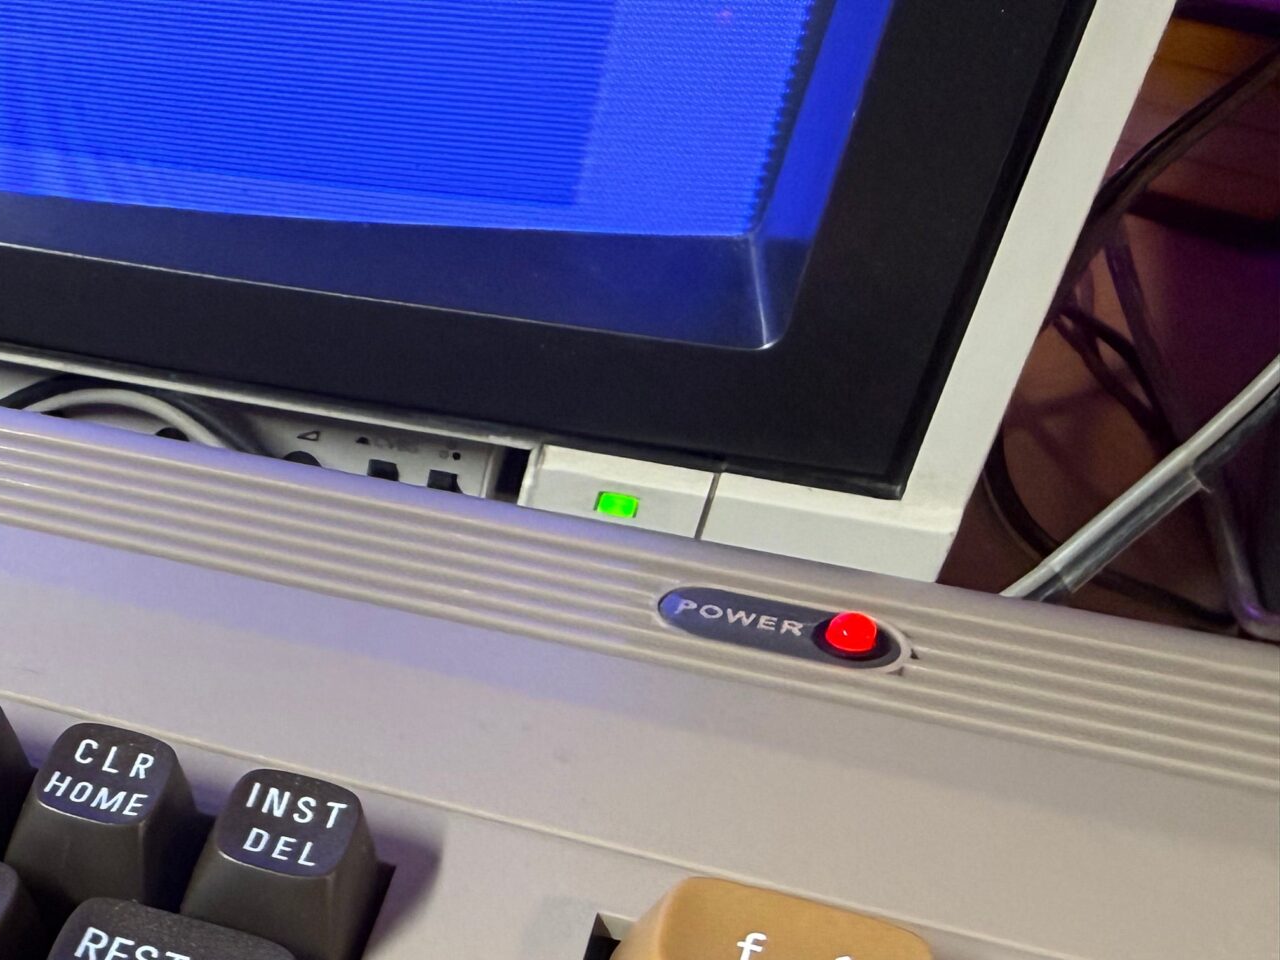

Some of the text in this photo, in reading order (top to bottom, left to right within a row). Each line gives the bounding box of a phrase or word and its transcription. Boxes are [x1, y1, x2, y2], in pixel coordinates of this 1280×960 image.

[672, 597, 805, 638] POWER
[73, 738, 155, 780] CLR
[42, 770, 150, 817] HOME
[245, 781, 349, 830] INST
[242, 827, 316, 867] DEL
